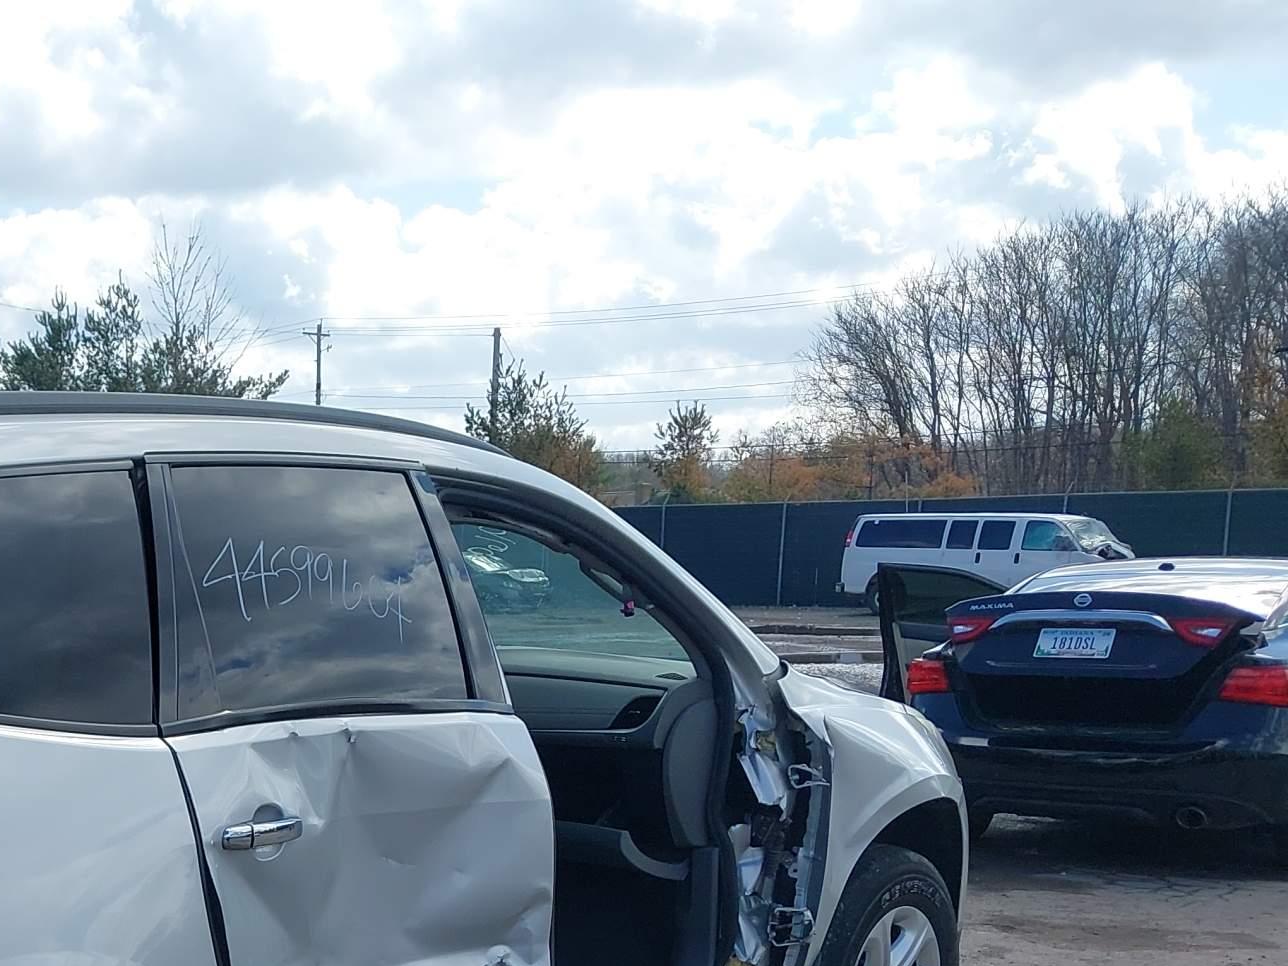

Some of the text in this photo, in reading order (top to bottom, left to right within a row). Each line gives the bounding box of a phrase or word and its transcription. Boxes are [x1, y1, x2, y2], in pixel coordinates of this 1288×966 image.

[202, 537, 413, 644] 44599604
[969, 602, 1014, 610] MAXIMA
[1049, 636, 1097, 650] 181DSL
